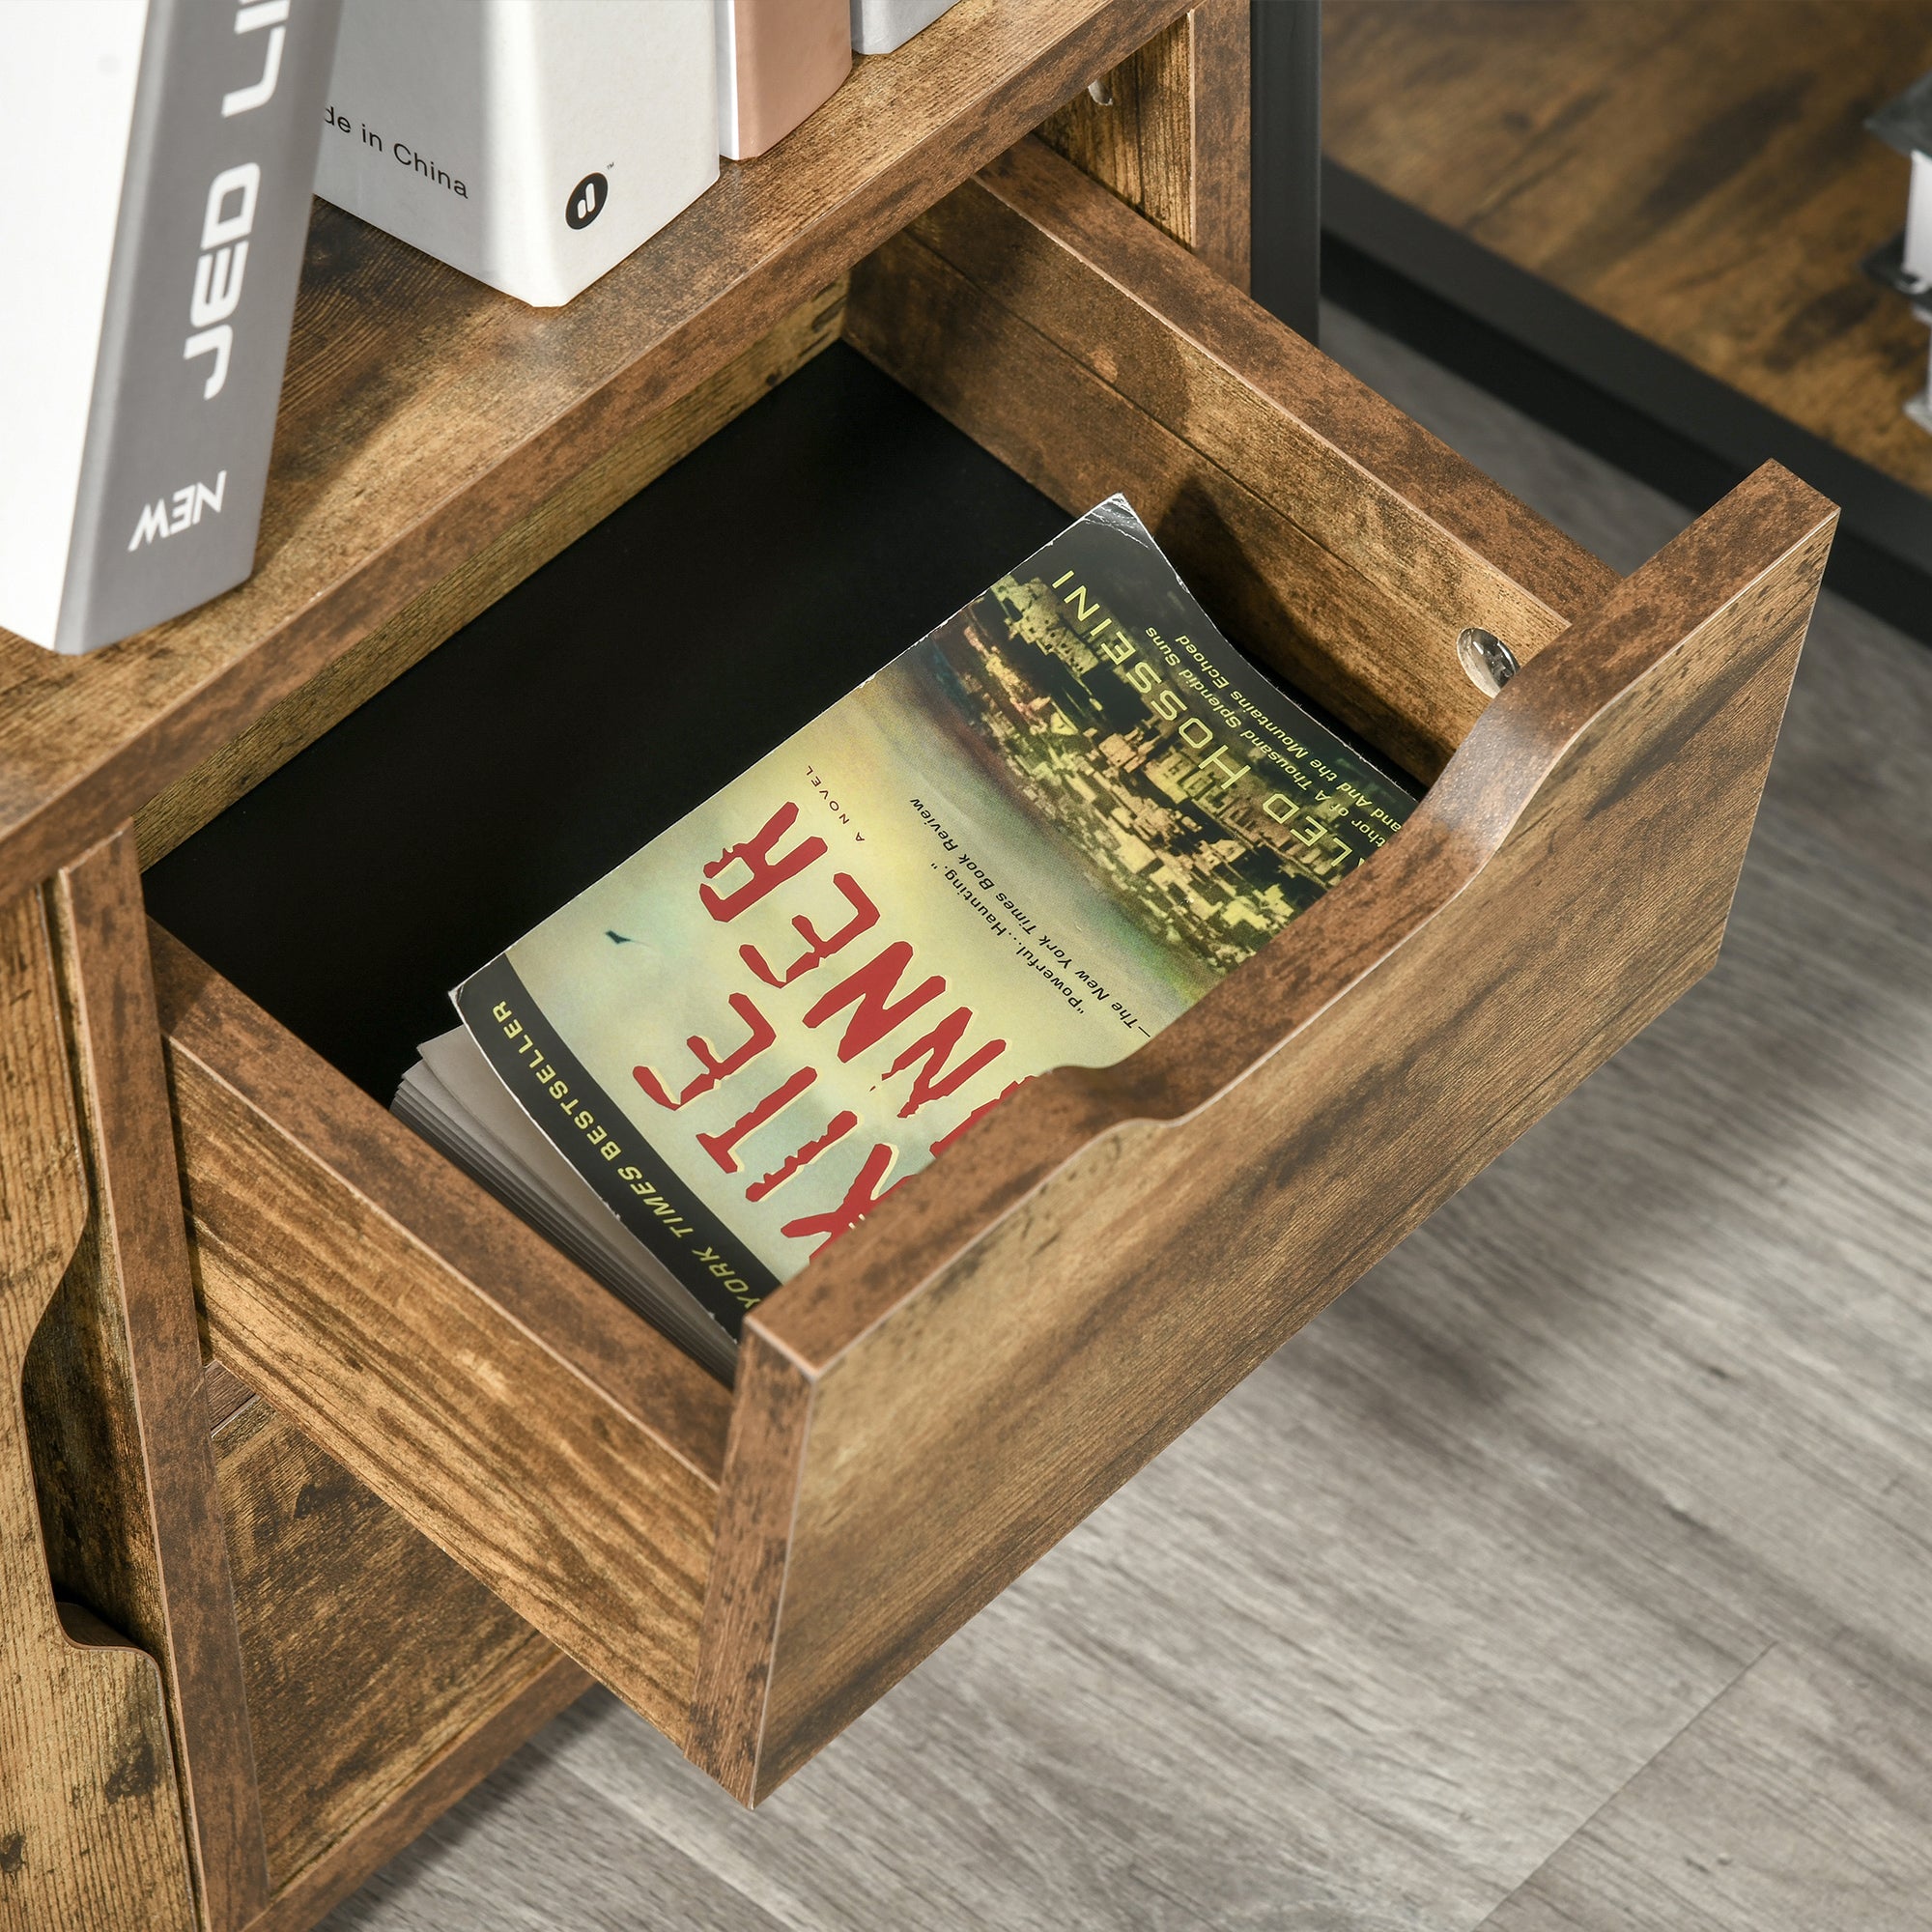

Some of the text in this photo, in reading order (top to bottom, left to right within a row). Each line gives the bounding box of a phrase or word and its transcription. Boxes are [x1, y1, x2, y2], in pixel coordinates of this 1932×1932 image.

[325, 106, 469, 199] de in China
[183, 0, 291, 401] JED LI
[128, 469, 227, 553] NEW
[1051, 570, 1365, 867] LED HOSSEINI
[1145, 626, 1386, 848] thor of A Thousand Splendid Suns
[1175, 635, 1403, 833] and And the Mountains Echoed
[806, 765, 866, 841] A NOVEL
[910, 798, 958, 852] Review
[958, 853, 995, 891] Book
[995, 892, 1037, 935] Times
[698, 801, 1037, 1159] NNER
[1038, 934, 1072, 970] York
[1074, 969, 1110, 1002] New
[492, 1001, 761, 1309] YORK TIMES BESTSELLER
[632, 992, 919, 1265] KITE
